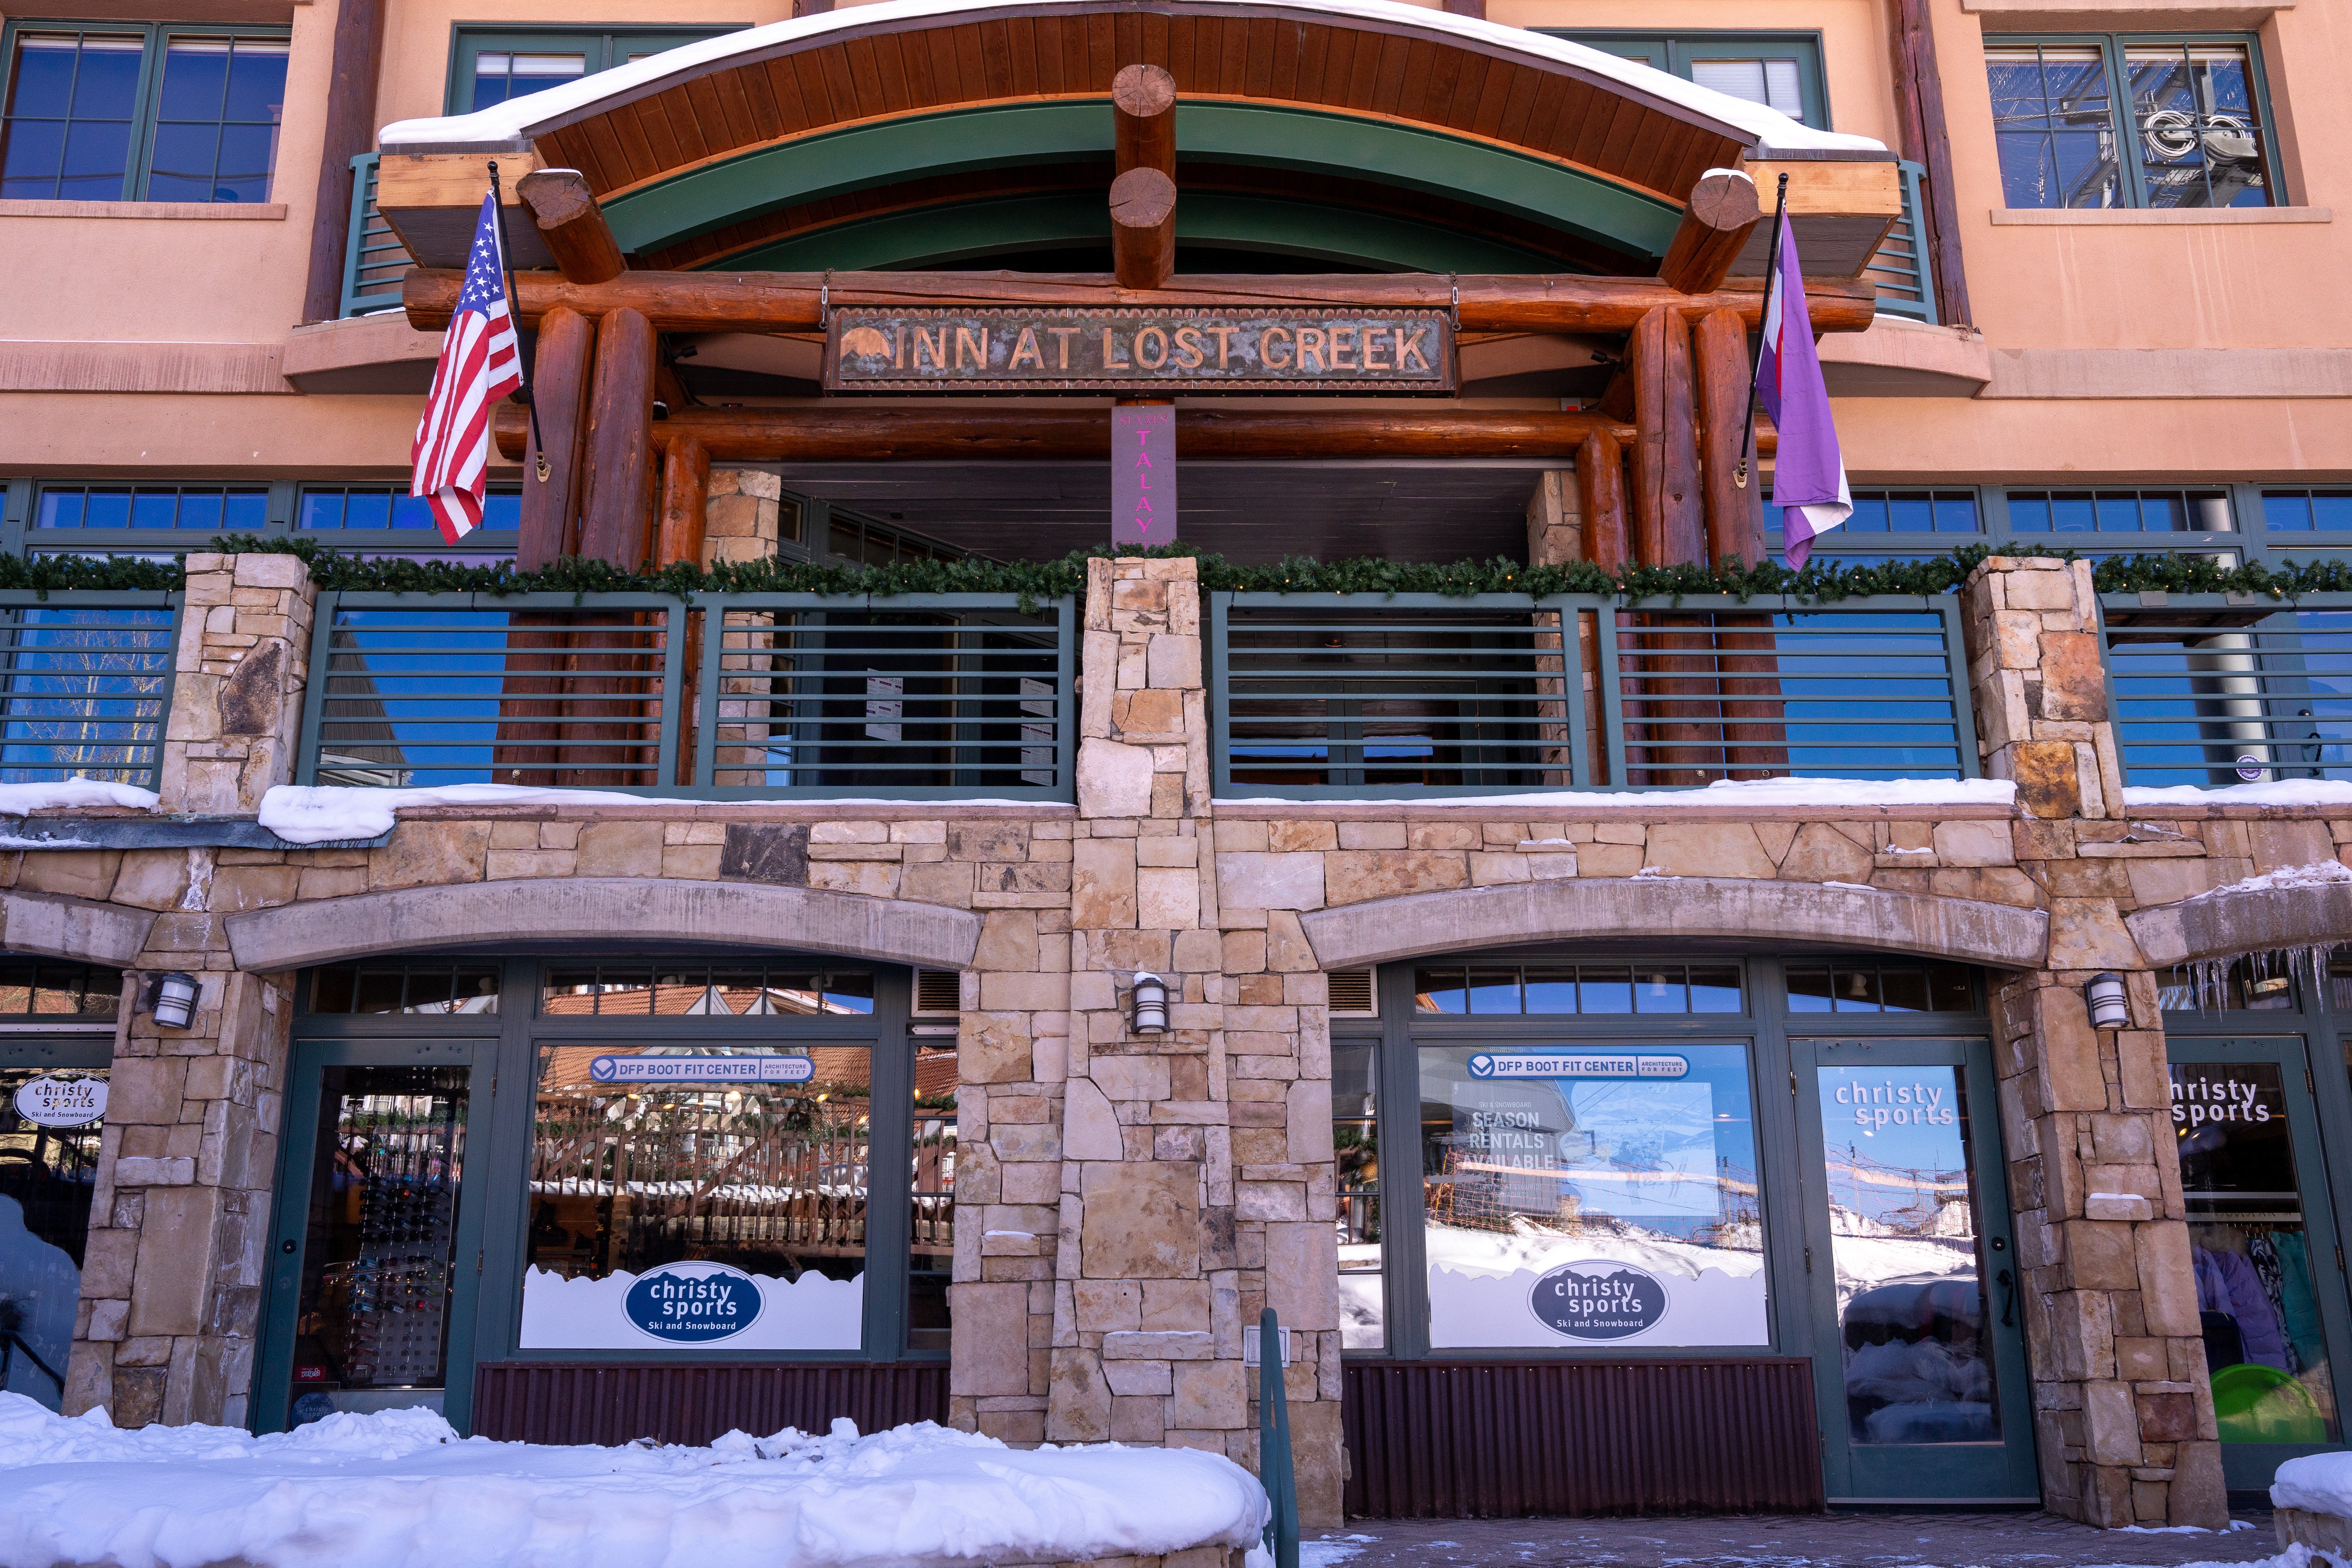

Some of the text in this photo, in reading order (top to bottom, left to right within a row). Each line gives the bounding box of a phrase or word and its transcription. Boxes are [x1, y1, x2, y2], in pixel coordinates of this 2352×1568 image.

[895, 326, 1430, 370] INN AT LOST CREEK
[1134, 429, 1154, 533] TALAY
[620, 1064, 756, 1075] DFP BOOT FIT CENTER
[1498, 1061, 1634, 1072] DFP BOOT FIT CENTER
[35, 1083, 93, 1098] christy
[1836, 1081, 1942, 1111] christy
[2169, 1077, 2257, 1106] hristy
[42, 1096, 95, 1111] sports
[2172, 1100, 2270, 1127] sports
[1472, 1112, 1539, 1128] SEASON
[1855, 1104, 1953, 1131] sports
[1470, 1132, 1544, 1149] RENTALS
[1462, 1154, 1554, 1170] AVAILABLE
[650, 1280, 732, 1305] christy
[1555, 1278, 1635, 1301] christy
[662, 1298, 737, 1320] sports
[1569, 1296, 1643, 1317] sports
[1593, 1319, 1644, 1327] Snowboard
